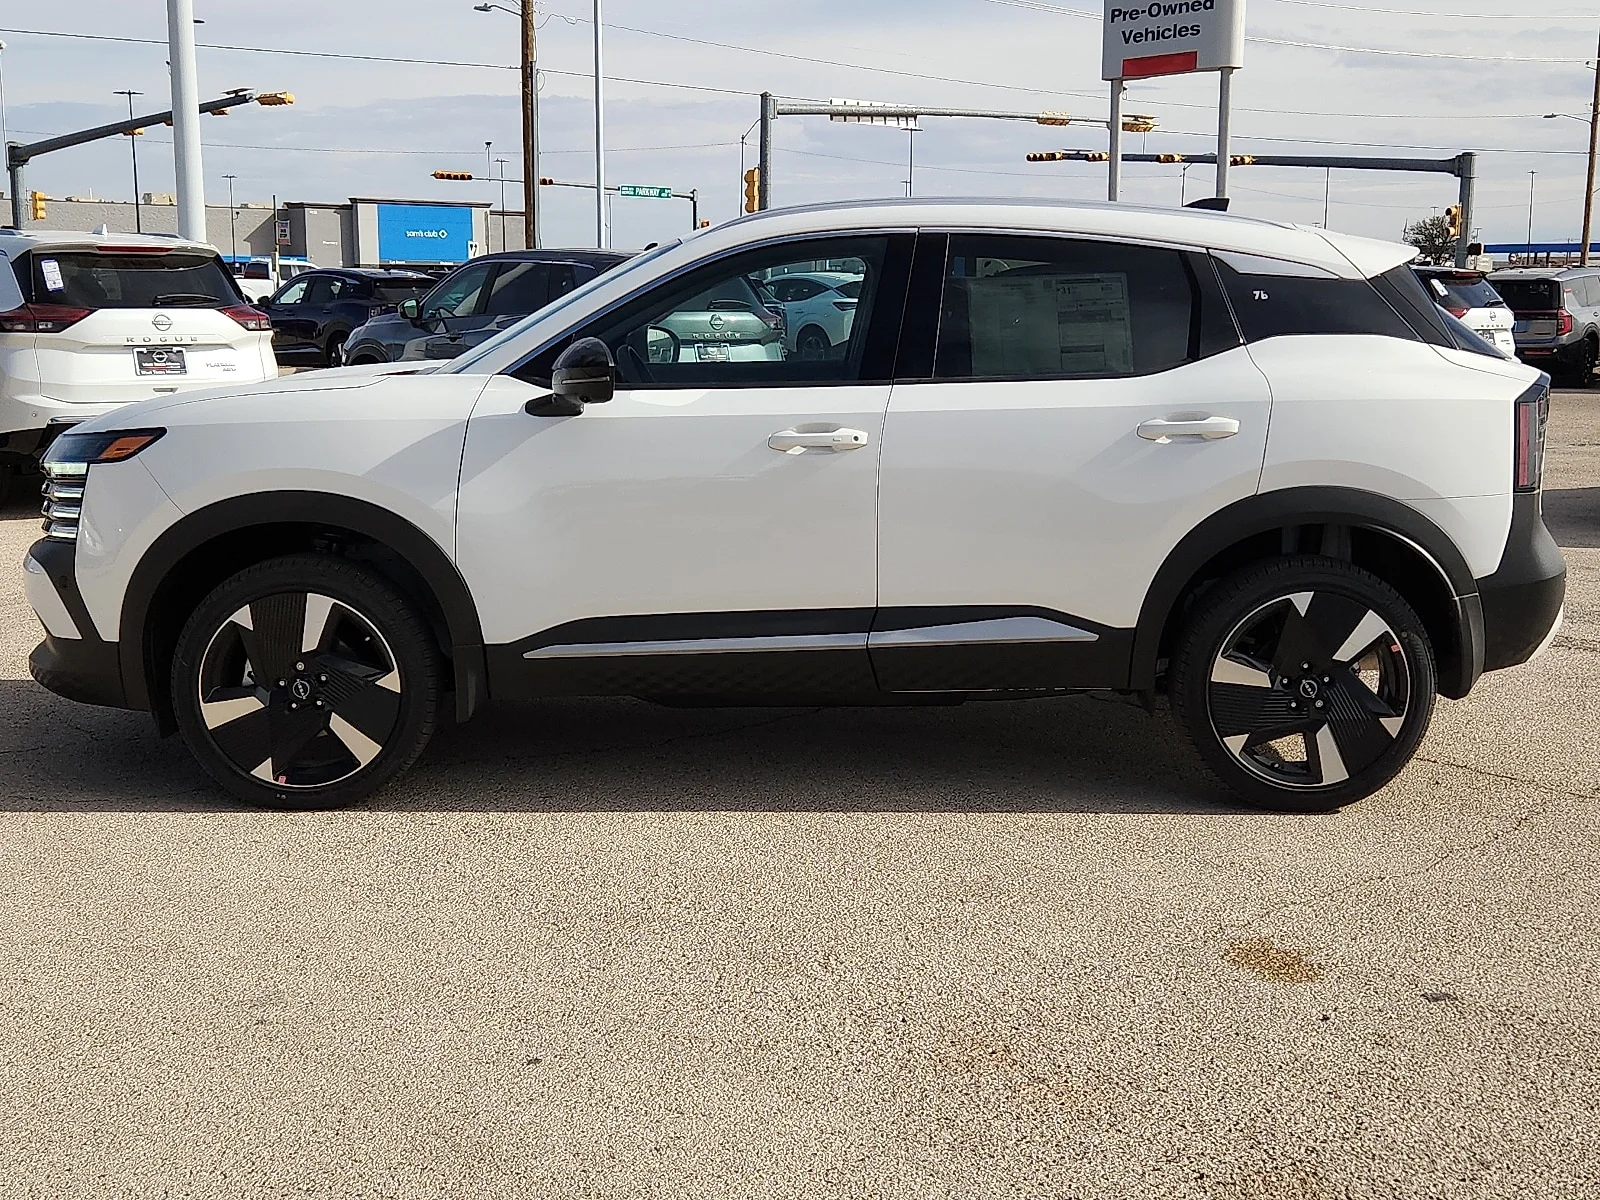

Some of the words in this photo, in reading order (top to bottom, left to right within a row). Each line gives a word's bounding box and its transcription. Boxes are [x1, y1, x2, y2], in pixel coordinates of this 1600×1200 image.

[1110, 0, 1215, 23] Pre-Owned
[1121, 23, 1201, 45] Vehicles
[635, 187, 660, 197] PARKWAY
[424, 230, 438, 238] club
